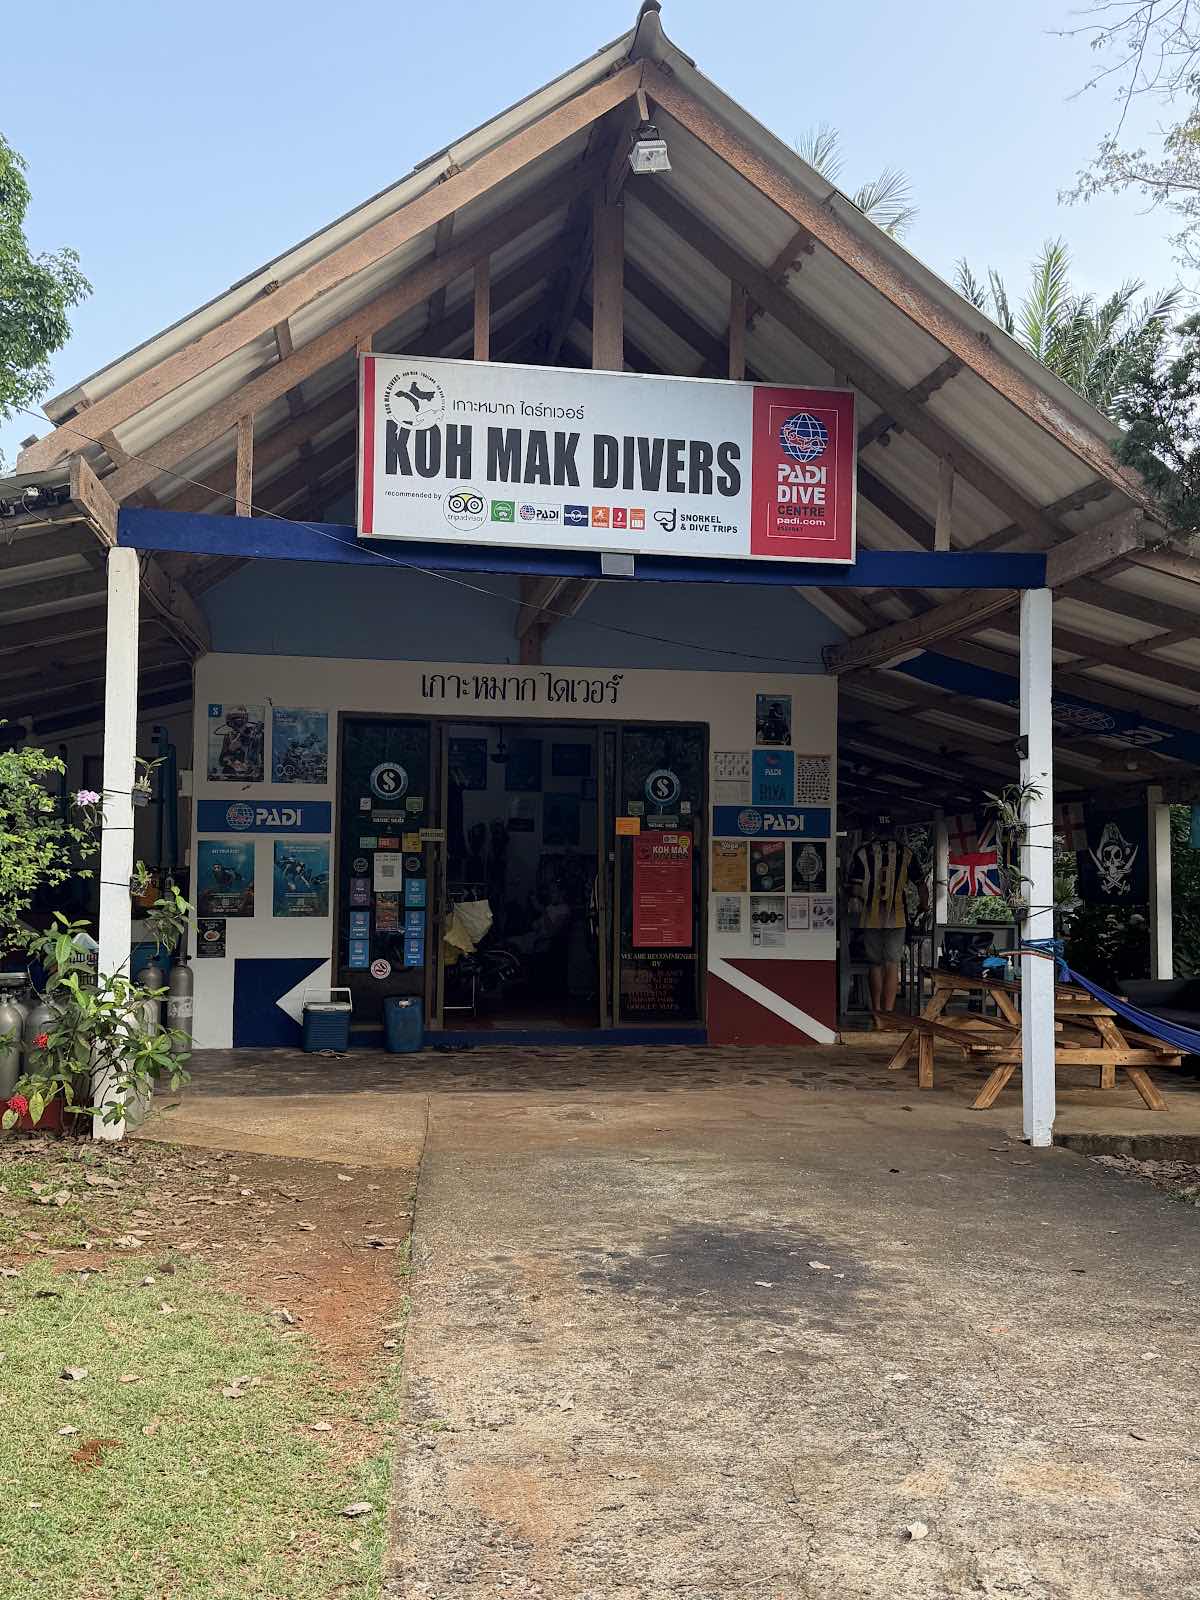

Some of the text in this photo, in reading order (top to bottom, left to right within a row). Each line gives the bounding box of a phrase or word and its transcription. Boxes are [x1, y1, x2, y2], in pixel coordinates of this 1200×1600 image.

[453, 399, 515, 415] เกาะหมาก
[385, 420, 741, 498] KOH MAK DIVERS
[777, 463, 828, 485] PADI
[384, 490, 442, 501] recommended by
[777, 484, 827, 505] DIVE
[536, 509, 559, 520] PADI
[777, 505, 826, 517] CENTRE
[447, 513, 483, 522] tripadvisor
[680, 513, 722, 524] SNORKEL
[776, 517, 826, 526] padi.com
[680, 523, 738, 534] & DIVE TRIPS
[421, 673, 536, 702] เกาะหมาก
[255, 808, 302, 826] PADI
[763, 813, 805, 832] PADI
[652, 846, 670, 854] KOH
